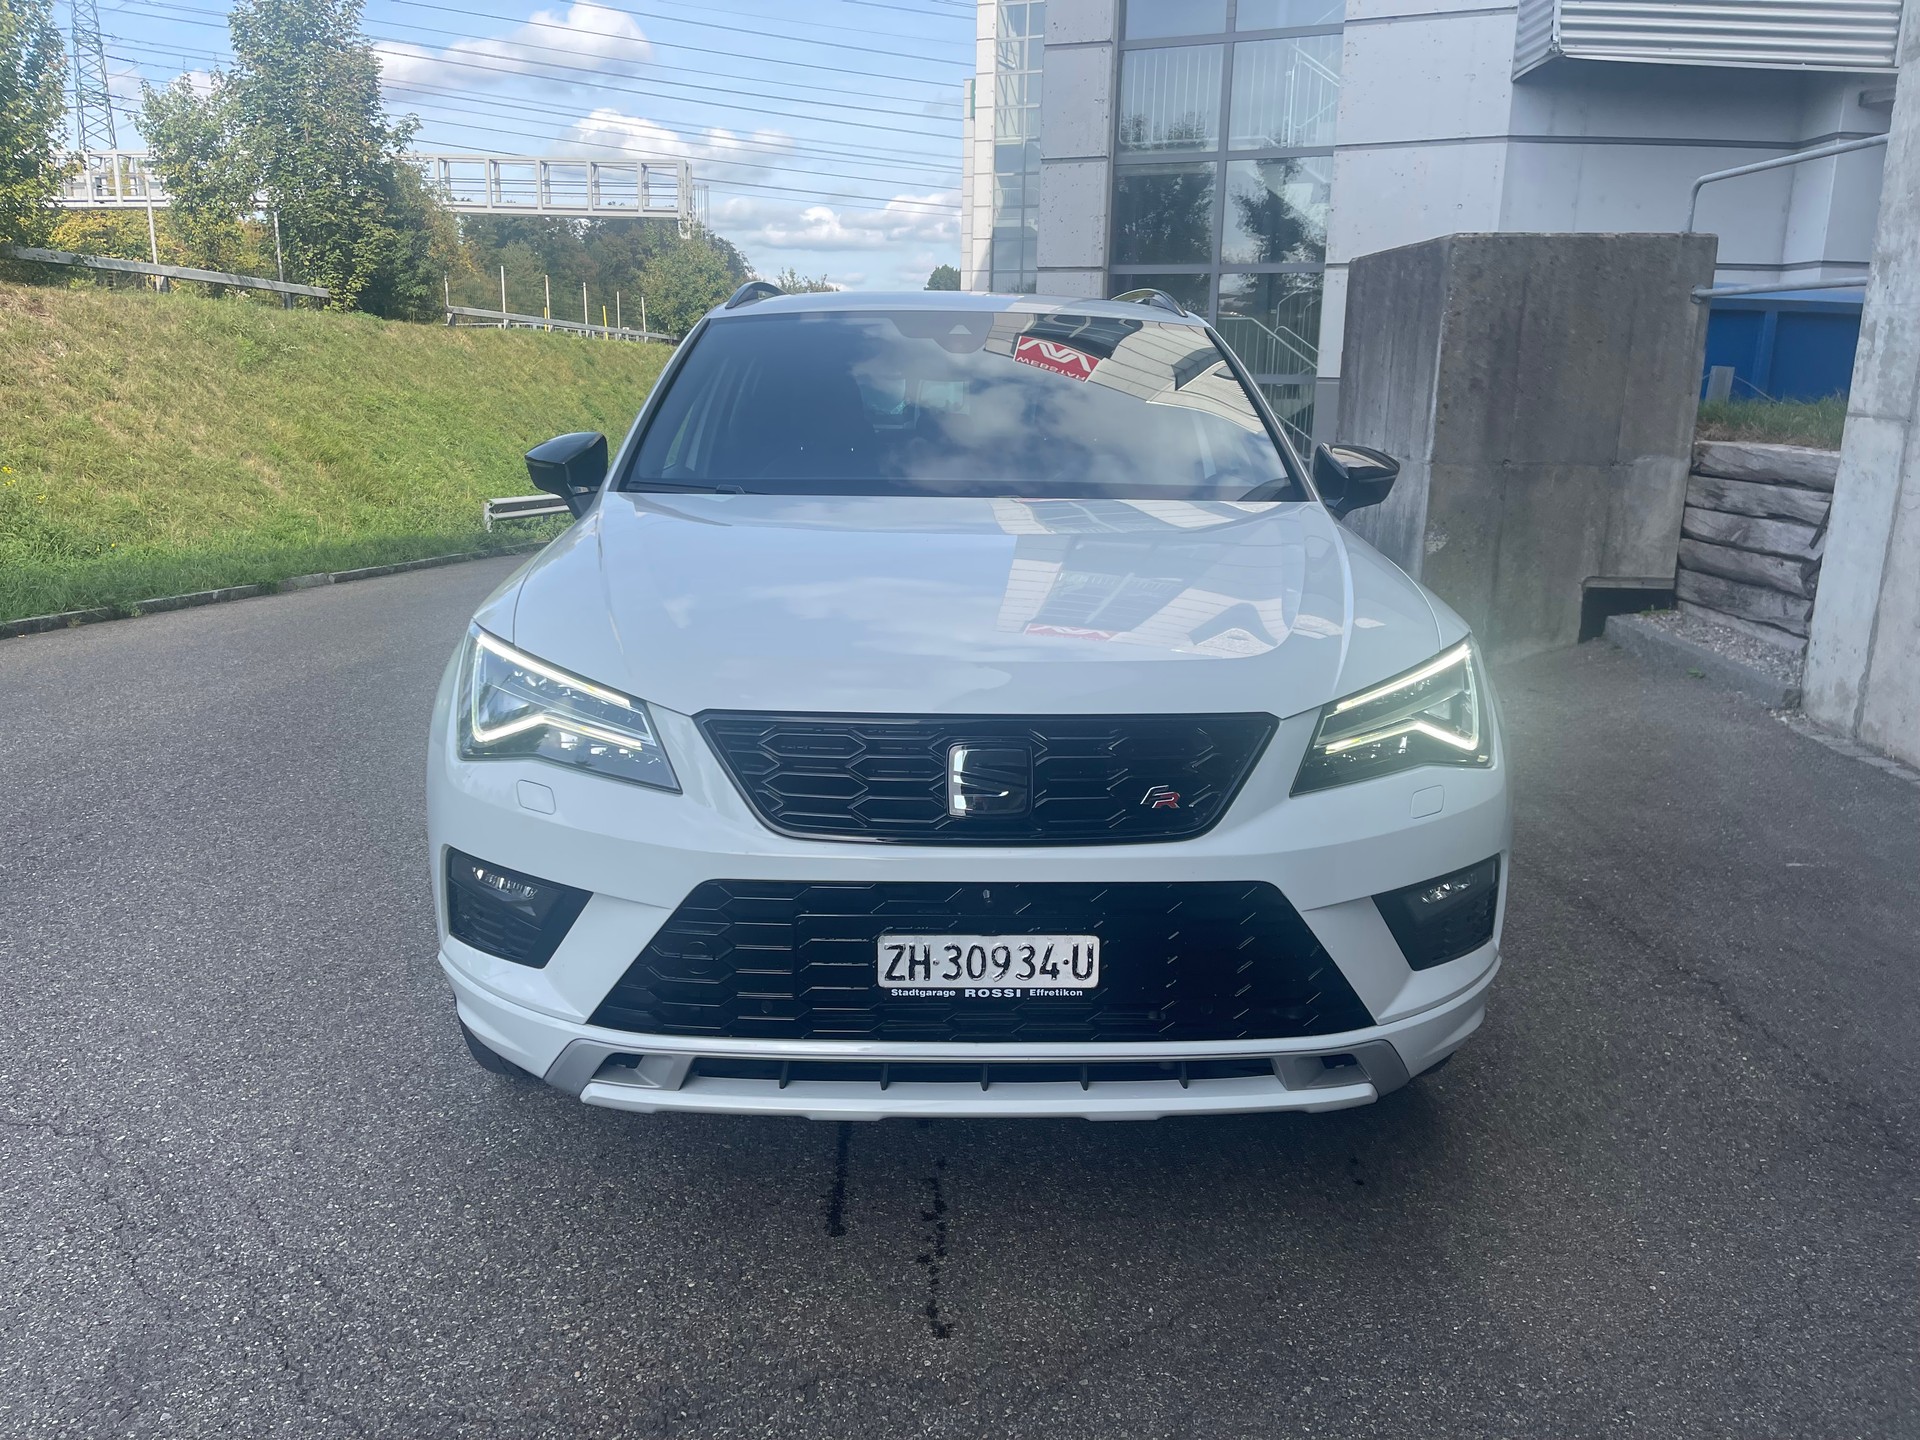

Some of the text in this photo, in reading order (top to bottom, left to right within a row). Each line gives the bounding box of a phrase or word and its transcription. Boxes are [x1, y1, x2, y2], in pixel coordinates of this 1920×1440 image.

[1140, 785, 1180, 808] FR
[891, 988, 1083, 998] Stadtgarage ROSSI Effretikon
